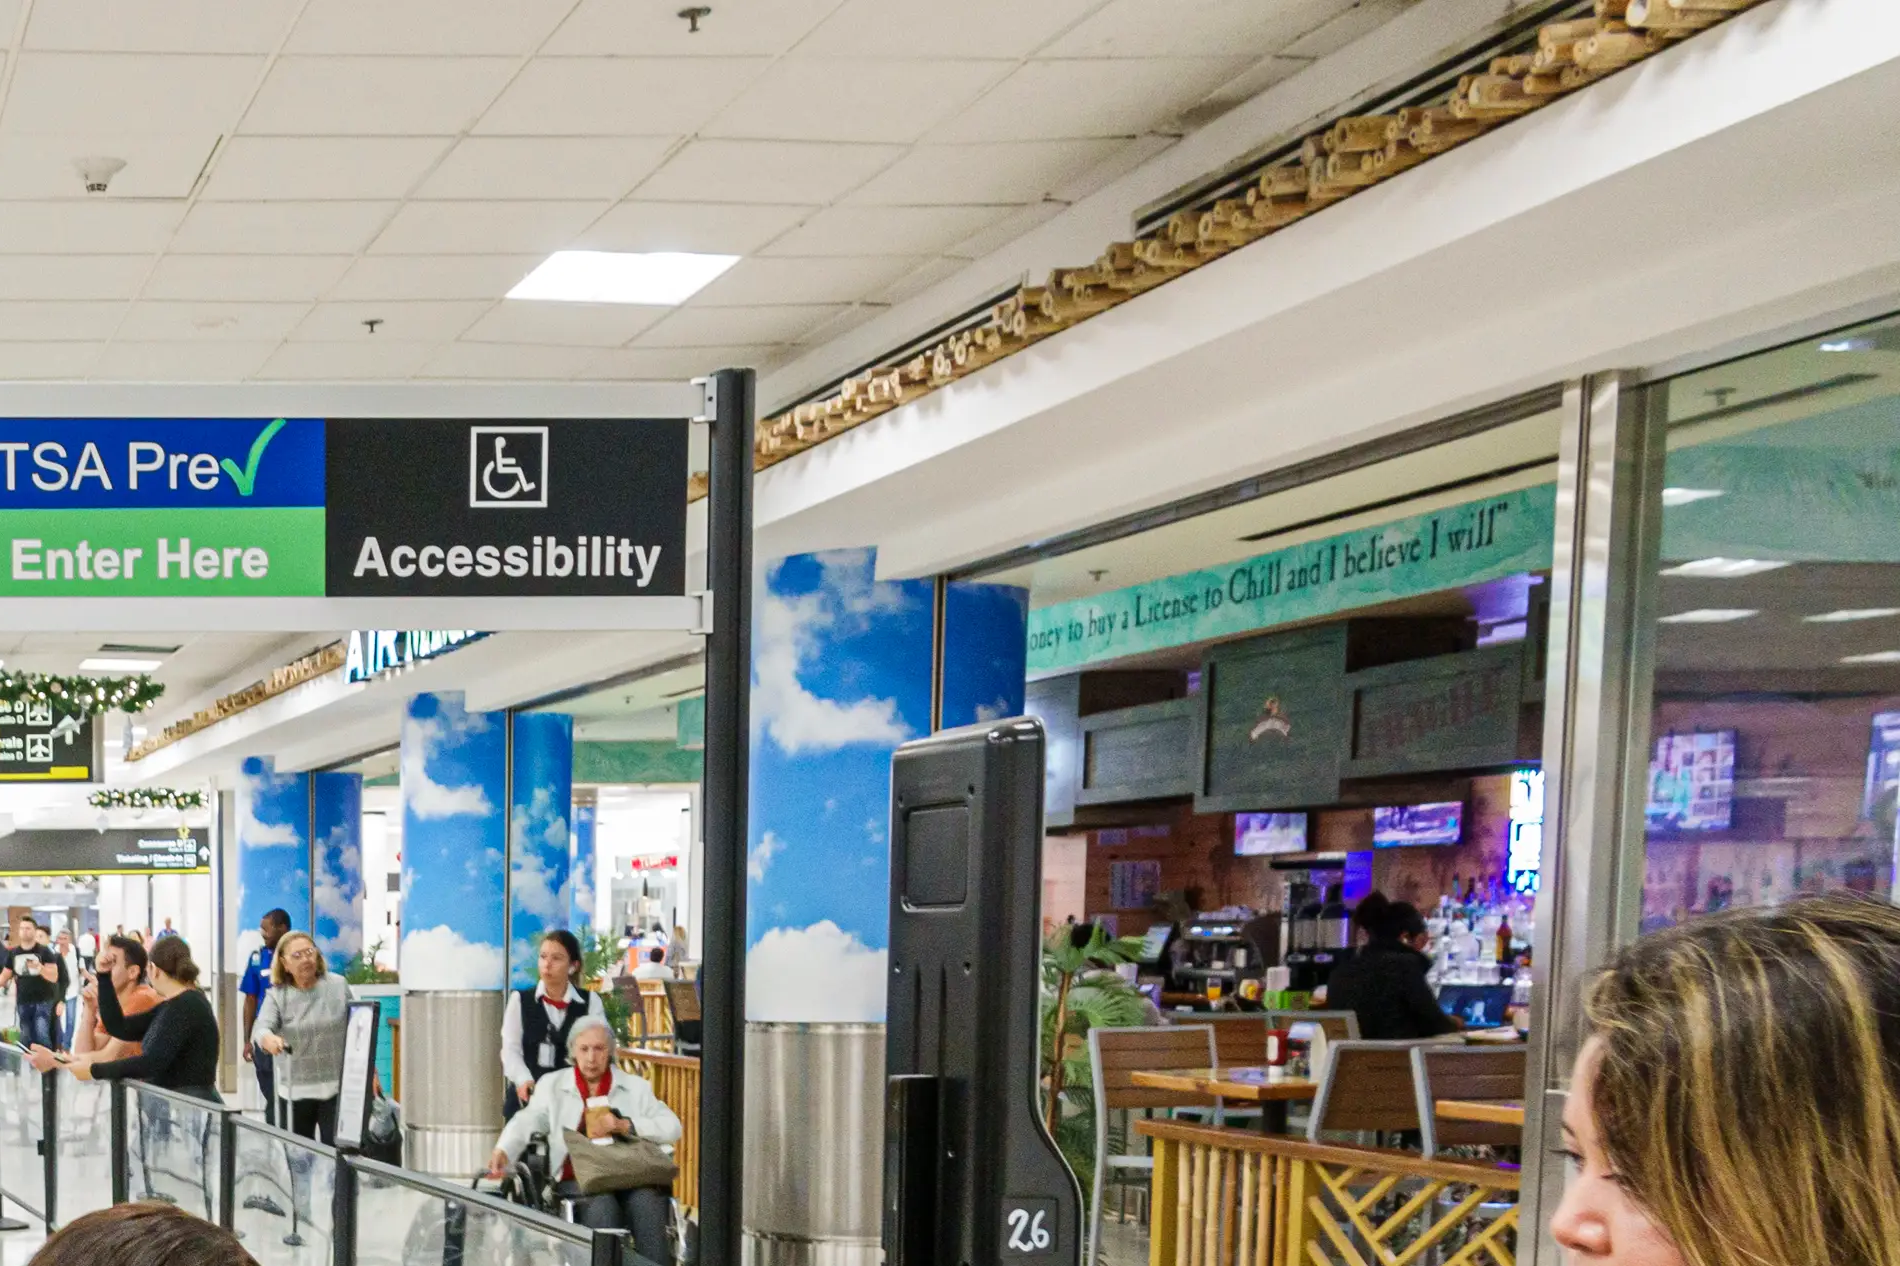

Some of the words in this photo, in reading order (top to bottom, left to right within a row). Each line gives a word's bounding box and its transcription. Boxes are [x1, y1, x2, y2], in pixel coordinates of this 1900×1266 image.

[128, 441, 220, 490] Pre
[11, 537, 143, 581] Enter
[156, 537, 270, 580] Here
[352, 535, 663, 588] Accessibility
[1028, 625, 1062, 653] oney
[1067, 618, 1084, 643] to
[1087, 607, 1117, 645] buy
[1121, 613, 1130, 630] a
[1134, 593, 1199, 629] License
[1204, 585, 1224, 609] to
[1228, 558, 1282, 605] Chill
[1287, 549, 1321, 591] and
[1328, 544, 1337, 582] I
[1343, 534, 1422, 579] believe
[1429, 518, 1439, 560] I
[1007, 1208, 1050, 1252] 26
